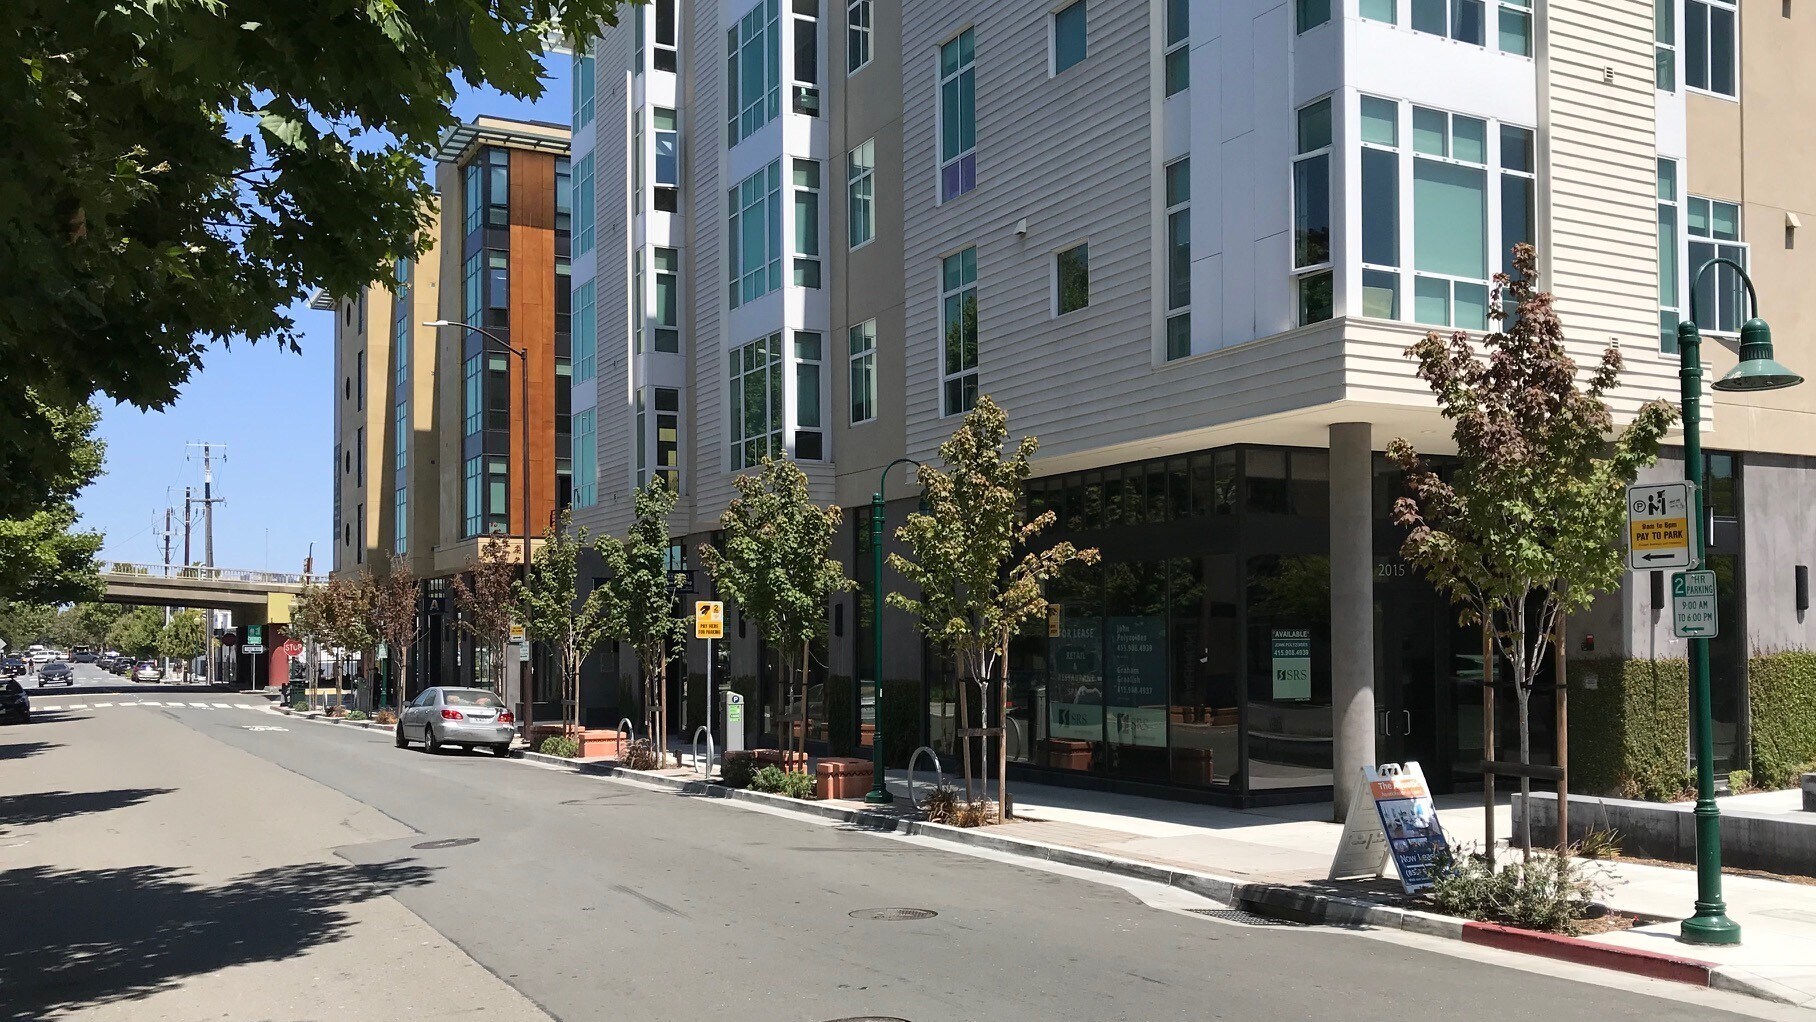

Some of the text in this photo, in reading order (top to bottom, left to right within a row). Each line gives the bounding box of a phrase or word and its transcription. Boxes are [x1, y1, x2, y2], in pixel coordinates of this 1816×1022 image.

[1636, 530, 1683, 541] PAY TO PARK
[1378, 564, 1405, 577] 2015
[1694, 575, 1706, 583] HR
[1674, 578, 1684, 594] 2
[1686, 585, 1713, 594] PARKING
[429, 599, 440, 610] A
[1682, 601, 1708, 610] 9:00 AM
[1678, 613, 1713, 622] TO 6:00 PM
[1073, 628, 1094, 638] LEASE
[285, 643, 303, 652] STOP
[1287, 669, 1307, 680] SRS
[1071, 713, 1088, 726] SRS
[1378, 782, 1392, 791] The
[1399, 854, 1417, 864] Now
